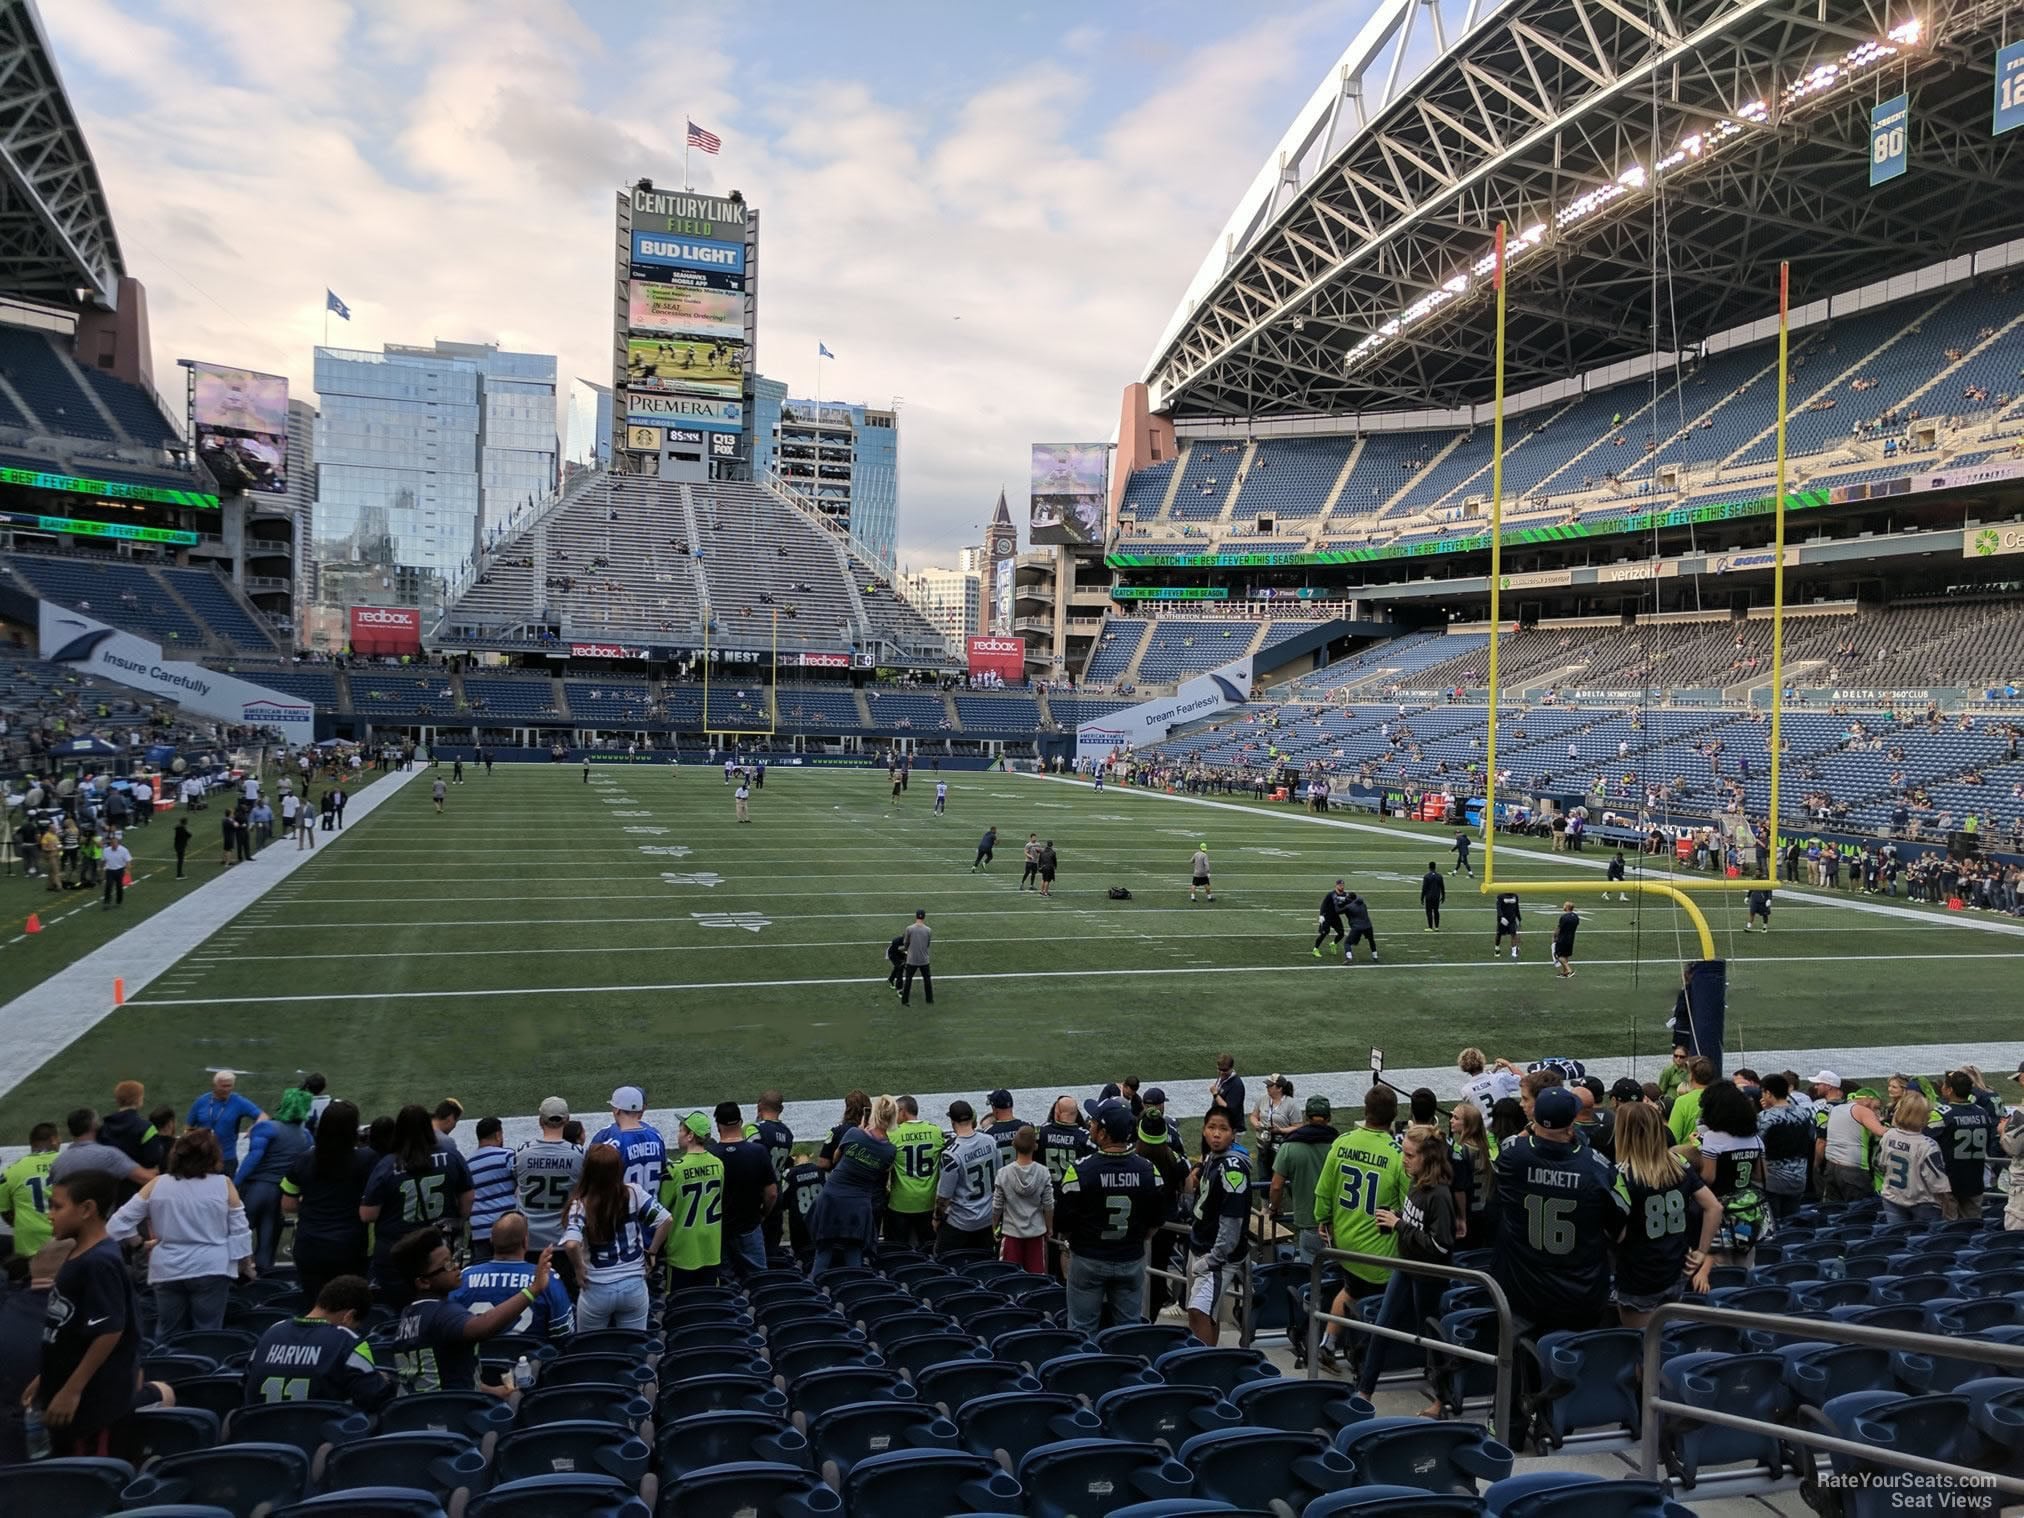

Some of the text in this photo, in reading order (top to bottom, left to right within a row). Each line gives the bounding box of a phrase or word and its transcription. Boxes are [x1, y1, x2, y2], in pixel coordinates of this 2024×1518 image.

[2001, 71, 2024, 110] 12
[1874, 127, 1903, 164] 80
[668, 217, 712, 236] FIELD
[641, 240, 736, 264] BUD LIGHT
[651, 308, 692, 318] Concessions
[629, 395, 713, 416] PREMERA
[713, 434, 735, 445] Q13
[714, 445, 734, 455] FOX
[12, 471, 37, 485] BEST
[44, 475, 80, 491] FEVER
[84, 481, 107, 494] THIS
[1603, 500, 1767, 532] CATCH THE BEST FEVER THIS SEASON
[1388, 534, 1511, 557] CATCH THE BEST FEVER THIS SEON
[1154, 554, 1305, 565] CATCH THE BEST FEVER THIS SEASON
[1611, 566, 1656, 582] verizon
[724, 650, 760, 663] NEST
[103, 650, 210, 696] Insure Carefully
[1582, 690, 1605, 698] DELTA
[1842, 690, 1874, 699] DELTA
[1146, 694, 1219, 725] Dream Fearlessly
[1472, 1082, 1492, 1093] WILSON
[1479, 1093, 1495, 1120] 3
[1953, 1115, 1980, 1125] THOMAS
[901, 1131, 933, 1142] LOCKETT
[1047, 1133, 1075, 1145] WAGNER
[1888, 1138, 1912, 1153] WILSON
[1954, 1128, 1988, 1160] 29
[526, 1157, 573, 1170] SHERMAN
[902, 1143, 934, 1177] 16
[964, 1144, 992, 1163] CHANCELLOR
[1225, 1156, 1240, 1169] 12
[1337, 1146, 1389, 1169] CHANCELLOR
[683, 1164, 720, 1180] BENNETT
[967, 1159, 996, 1200] 31
[1100, 1172, 1140, 1188] WILSON
[1527, 1166, 1581, 1189] LOCKETT
[1735, 1161, 1753, 1189] 3
[1888, 1153, 1909, 1190] 3
[400, 1174, 446, 1222] 16
[524, 1174, 570, 1210] 25
[1338, 1162, 1381, 1217] 31
[681, 1179, 721, 1228] 72
[1644, 1189, 1687, 1239] 88
[1101, 1195, 1132, 1240] 3
[1524, 1193, 1577, 1255] 16
[265, 1344, 322, 1366] HARVIN
